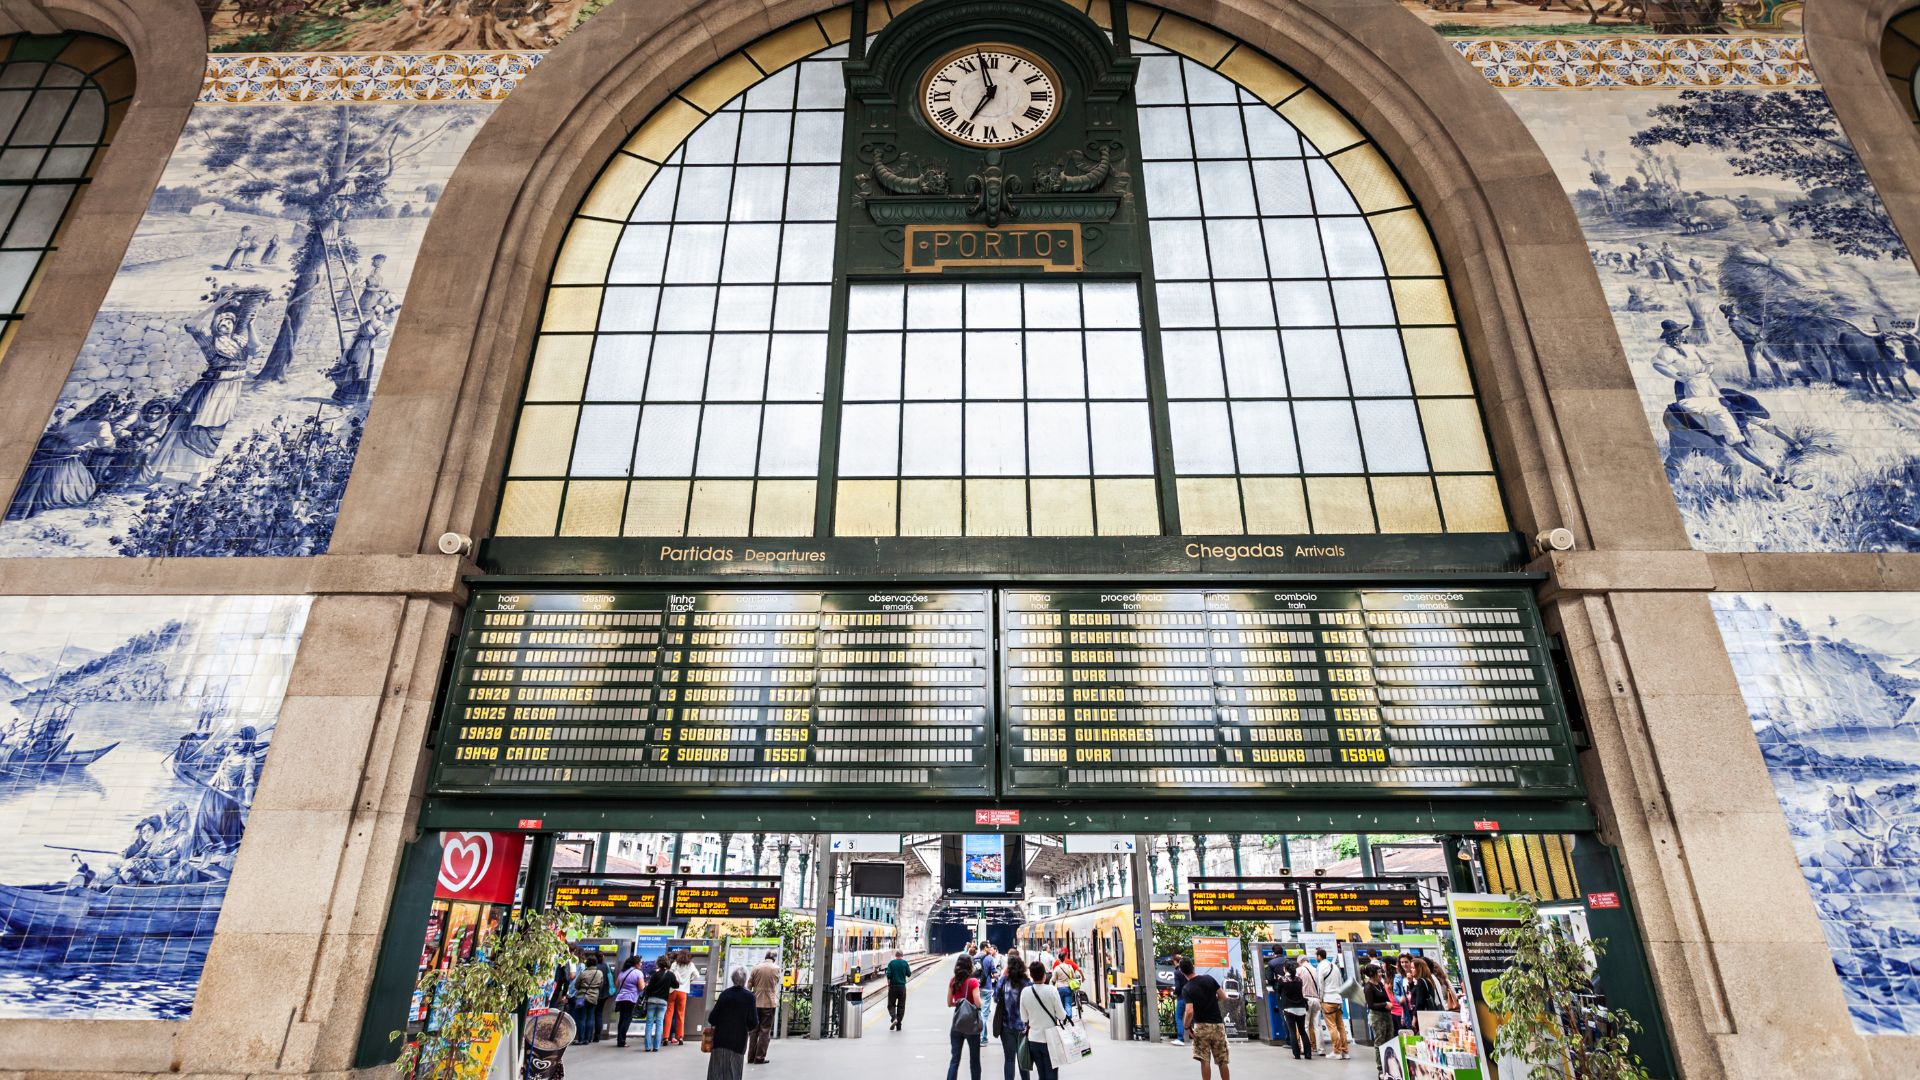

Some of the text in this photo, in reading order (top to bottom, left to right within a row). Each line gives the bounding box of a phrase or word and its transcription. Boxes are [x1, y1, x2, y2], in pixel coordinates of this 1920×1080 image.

[934, 231, 1052, 258] PORTO
[660, 546, 826, 563] Partidas Departures
[1185, 543, 1345, 561] Chegadas Arrivals
[498, 595, 520, 603] hora
[582, 595, 615, 603] destino
[670, 595, 696, 604] linha
[868, 593, 929, 604] observações
[1029, 593, 1051, 602] hora
[1101, 593, 1163, 603] procedência
[1274, 593, 1317, 601] comboio
[1402, 592, 1464, 602] observações
[882, 603, 913, 611] remarks
[1123, 602, 1141, 610] from
[677, 614, 686, 626] 6
[824, 614, 881, 626] PARTIDA
[1070, 613, 1112, 625] REGUA
[480, 632, 521, 644] 19H05
[675, 633, 684, 645] 4
[1070, 632, 1138, 644] PENAFIEL
[476, 651, 518, 662] 19H10
[525, 651, 559, 662] OVAR
[672, 651, 682, 663] 3
[888, 651, 905, 663] DA
[1071, 650, 1114, 662] BRAGA
[1324, 650, 1368, 662] 15242
[472, 669, 514, 681] 19H15
[521, 669, 564, 681] BRAGA
[670, 670, 679, 682] 2
[1072, 669, 1107, 682] OVAR
[1327, 669, 1371, 682] 15838
[468, 688, 511, 700] 19H20
[518, 688, 593, 700] GUIMARAES
[668, 689, 676, 701] 3
[685, 689, 735, 701] SUBURB
[1073, 688, 1125, 701] AVEIRO
[1331, 688, 1374, 701] 15644
[464, 707, 810, 721] 19H25 REGUA 1 IR 875
[1023, 708, 1066, 721] 19H30
[1074, 708, 1118, 721] CAIDE
[1247, 708, 1300, 722] SUBURB
[1334, 708, 1378, 721] 15546
[460, 727, 809, 741] 19H30 CAIDE 5 SUBURB 15549
[1023, 728, 1067, 742] 19H35
[1075, 728, 1154, 742] GUIMARAES
[1250, 728, 1303, 742] SUBURB
[1337, 728, 1382, 742] 15172
[455, 747, 806, 762] 19H40 CAIDE 2 SUBURB 15551
[1023, 748, 1386, 762] 19H40 OVAR 4 SUBURB 15840
[848, 841, 854, 850] 3
[1114, 843, 1119, 851] 4
[1462, 927, 1490, 938] PREÇO A
